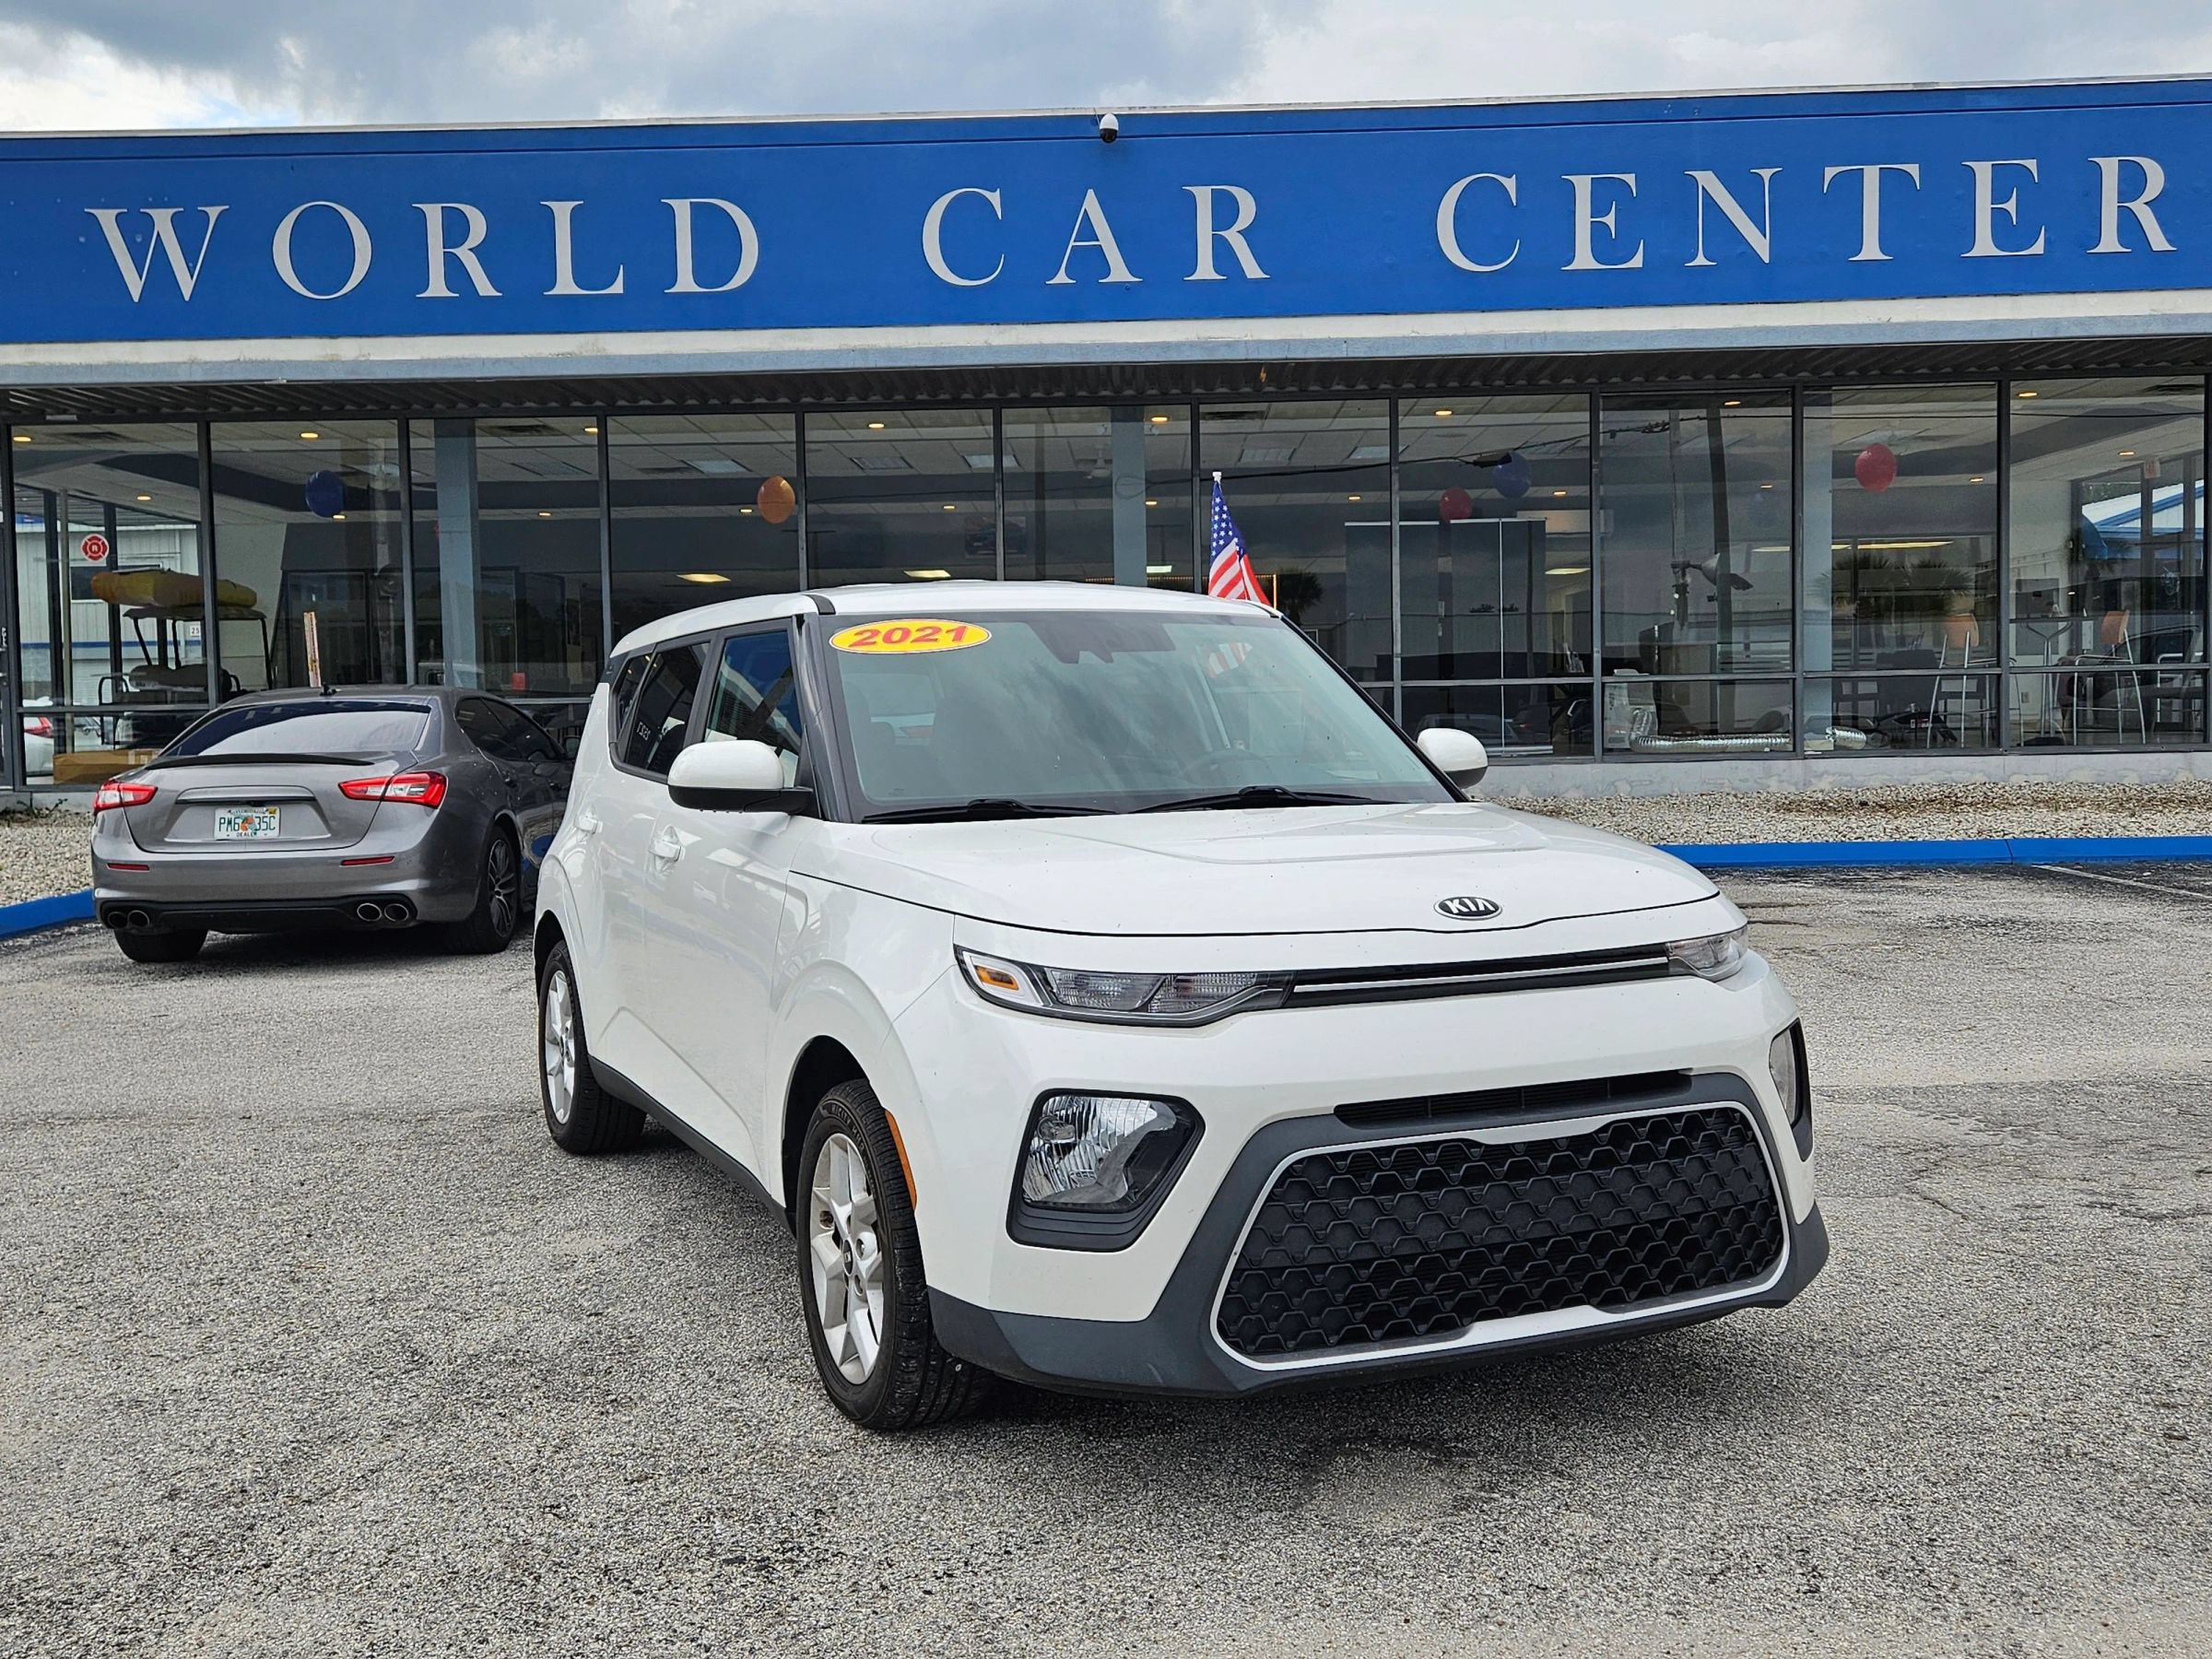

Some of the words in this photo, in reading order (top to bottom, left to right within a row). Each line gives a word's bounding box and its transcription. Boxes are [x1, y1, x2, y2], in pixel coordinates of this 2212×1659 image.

[85, 197, 759, 302] WORLD
[922, 185, 1270, 287] CAR
[1435, 156, 2177, 273] CENTER
[848, 625, 967, 648] 2021
[1443, 898, 1496, 914] KIA
